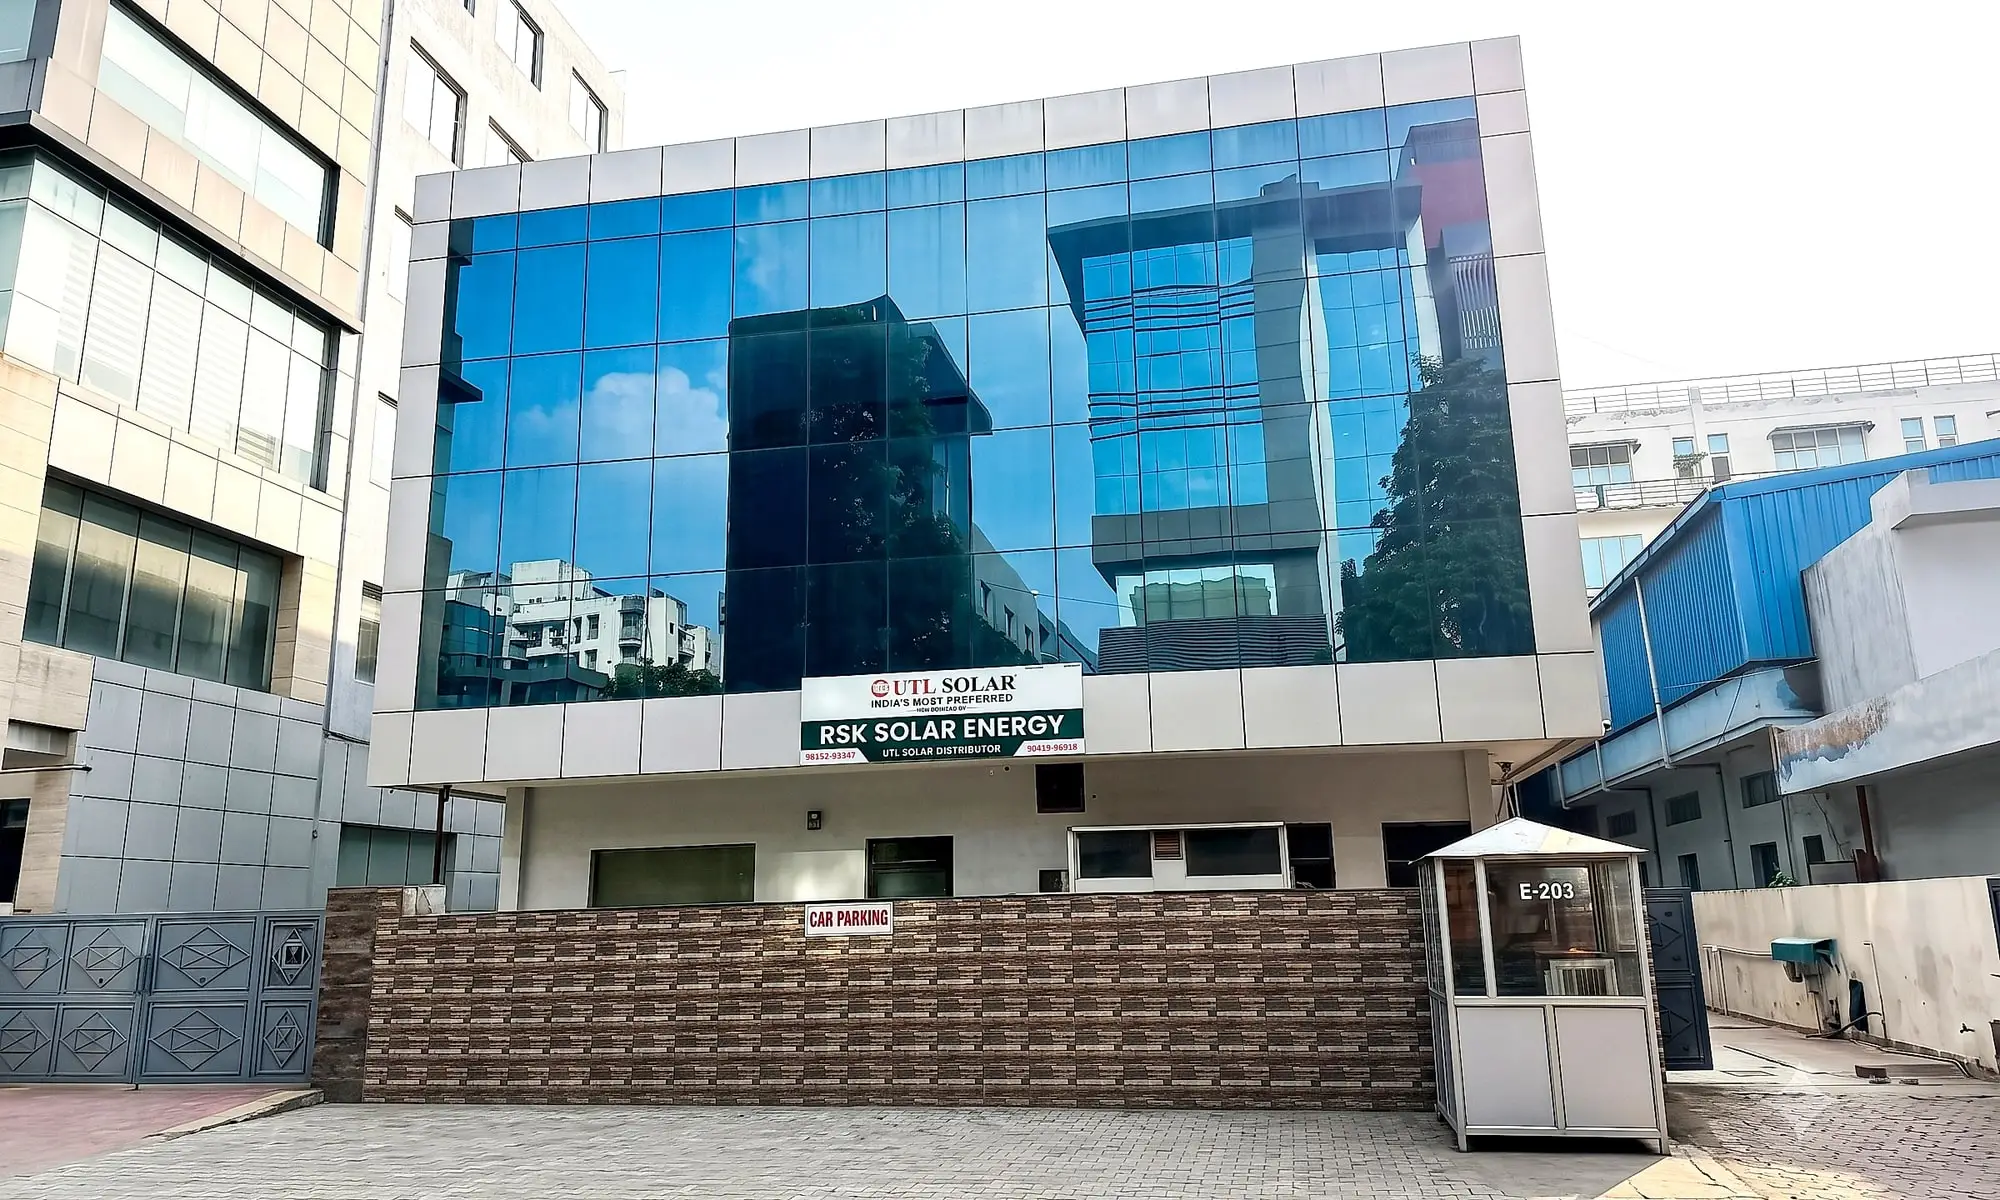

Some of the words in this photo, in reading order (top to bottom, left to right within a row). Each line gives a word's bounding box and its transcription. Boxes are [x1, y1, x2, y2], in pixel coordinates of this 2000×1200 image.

[893, 679, 936, 696] UTL
[942, 675, 1016, 693] SOLAR
[871, 698, 910, 708] INDIA'S
[913, 697, 943, 706] MOST
[946, 694, 1013, 704] PREFERRED
[820, 724, 867, 745] RSK
[874, 719, 956, 742] SOLAR
[963, 714, 1065, 738] ENERGY
[882, 749, 900, 757] UTL
[902, 747, 933, 756] SOLAR
[936, 745, 1001, 755] DISTRIBUTOR
[1026, 743, 1078, 752] 90419-96918
[805, 751, 856, 760] 98152-93347
[1520, 883, 1574, 900] E-203
[810, 911, 833, 927] CAR
[837, 909, 888, 926] PARKING
